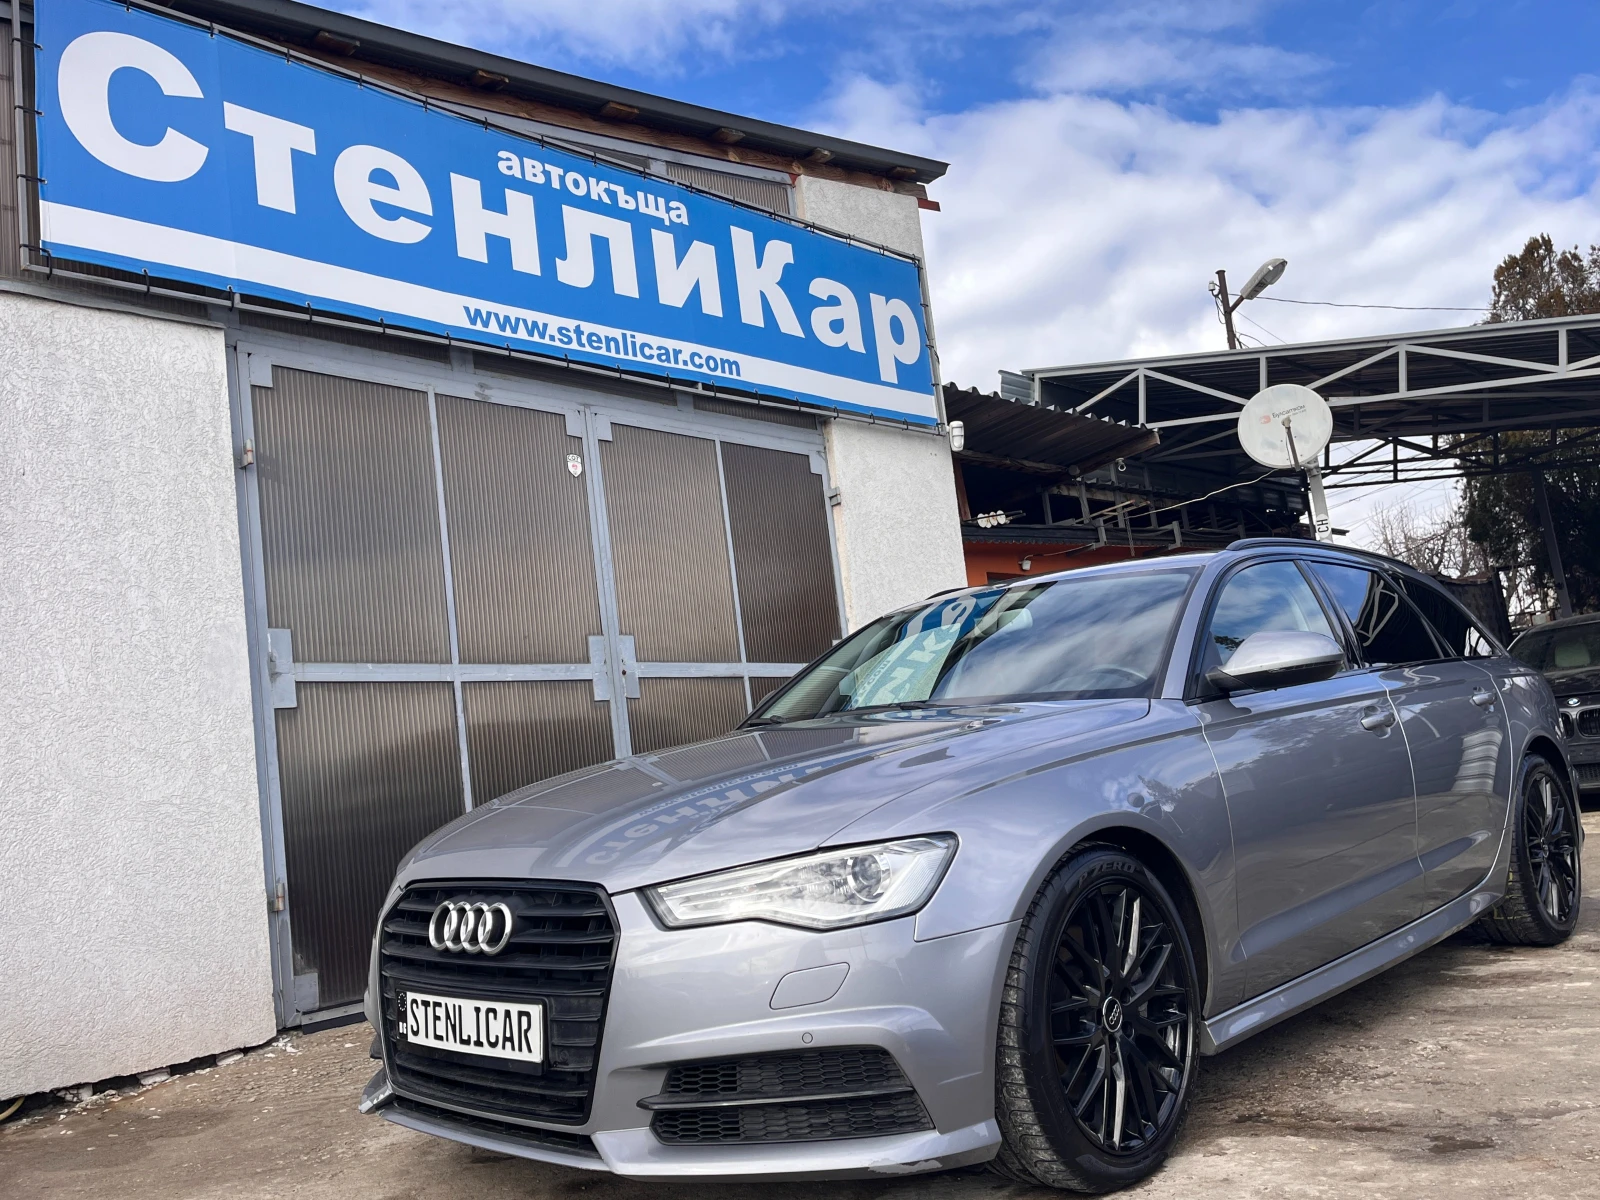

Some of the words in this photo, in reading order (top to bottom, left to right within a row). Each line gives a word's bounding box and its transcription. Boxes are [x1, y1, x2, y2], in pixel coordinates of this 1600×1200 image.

[57, 31, 921, 384] СтенлиКар
[497, 150, 690, 227] автокъща
[463, 305, 742, 378] www.stenlicar.com
[1092, 861, 1137, 877] ZERO
[410, 997, 533, 1054] STENLICAR
